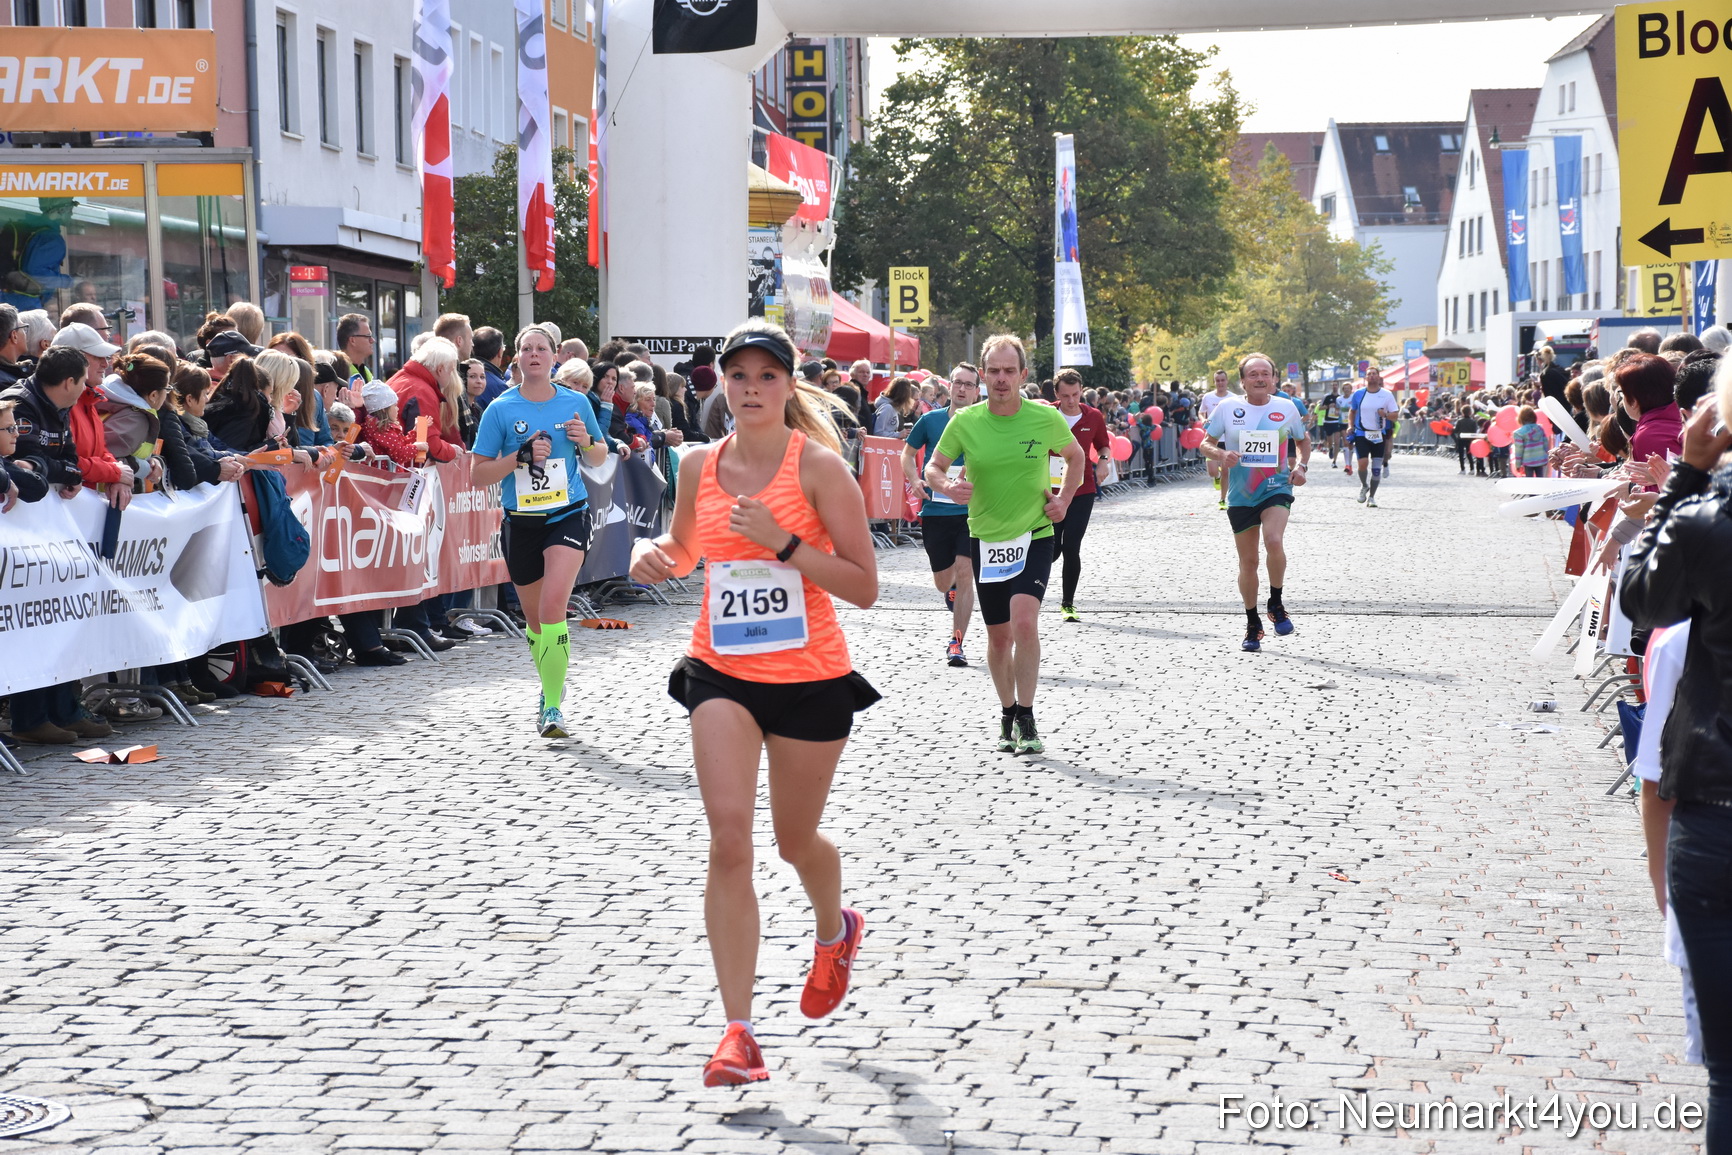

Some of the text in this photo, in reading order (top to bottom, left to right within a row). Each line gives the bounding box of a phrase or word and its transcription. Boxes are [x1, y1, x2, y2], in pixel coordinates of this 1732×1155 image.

[1658, 76, 1732, 205] A
[893, 269, 925, 281] Block
[1653, 272, 1676, 303] B
[899, 285, 920, 314] B
[1159, 354, 1171, 372] C
[1458, 368, 1468, 381] D
[1245, 441, 1272, 453] 2791
[531, 475, 551, 491] 52
[532, 493, 553, 502] Martina
[988, 546, 1024, 564] 2580
[721, 587, 789, 618] 2159
[743, 626, 768, 638] Julia
